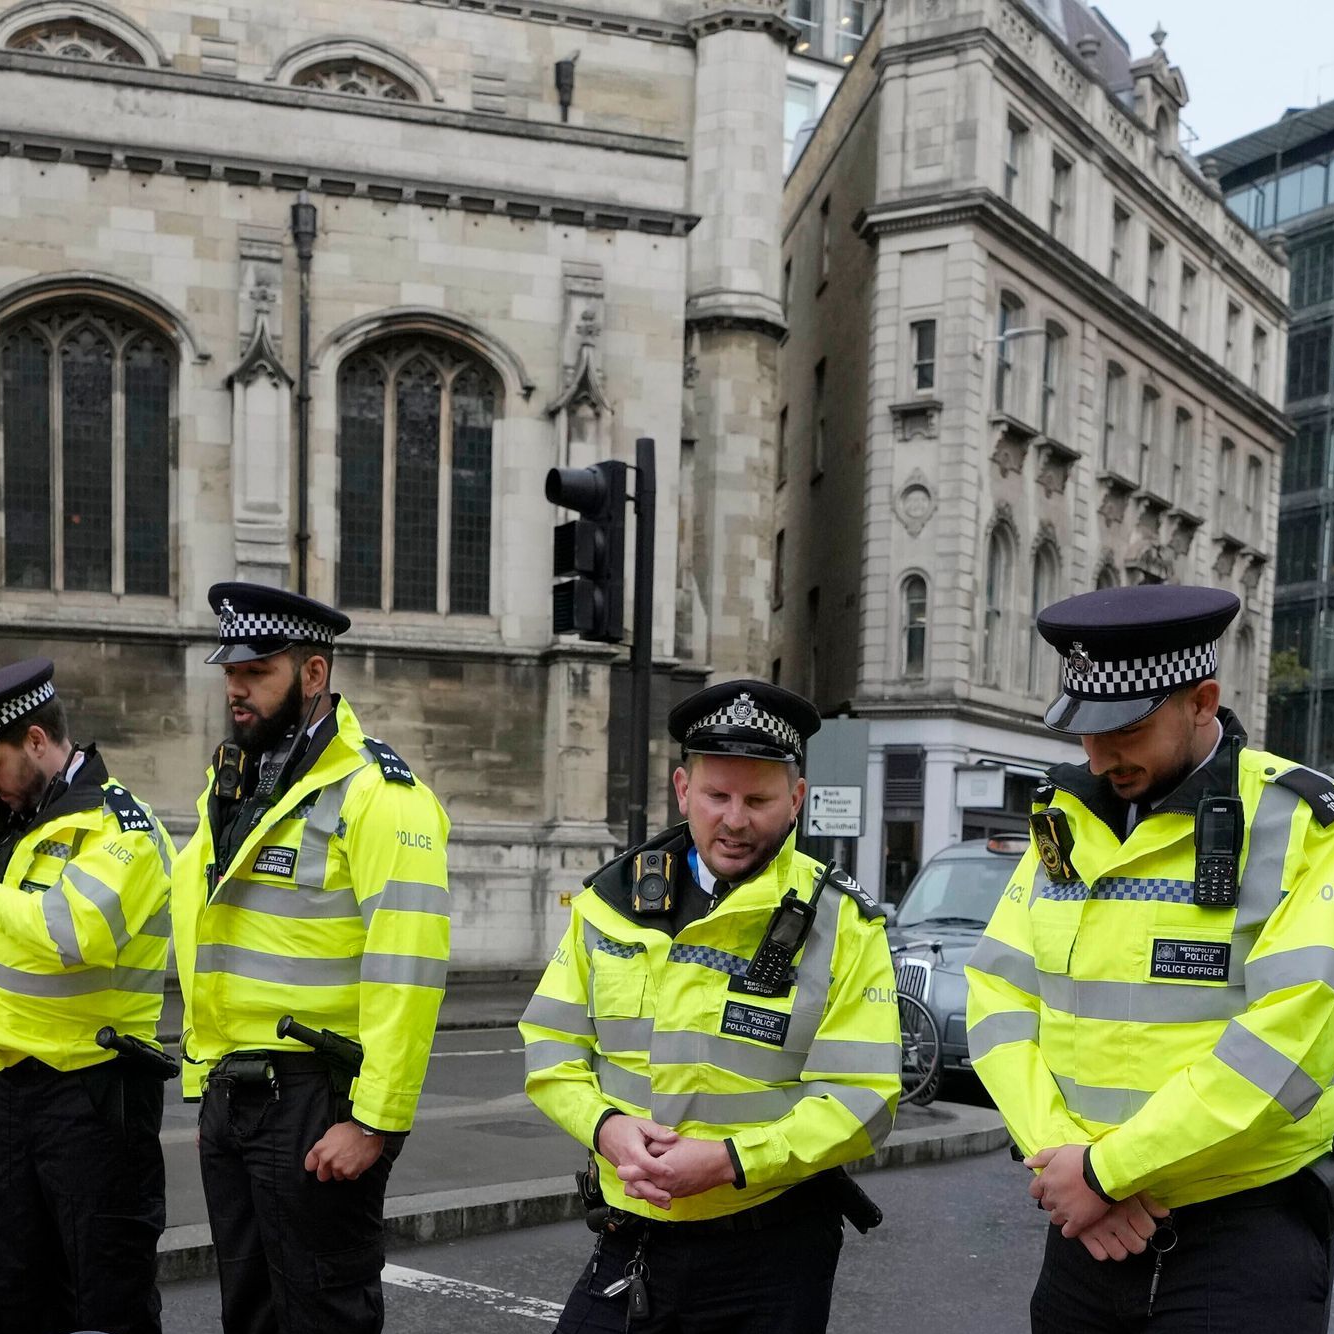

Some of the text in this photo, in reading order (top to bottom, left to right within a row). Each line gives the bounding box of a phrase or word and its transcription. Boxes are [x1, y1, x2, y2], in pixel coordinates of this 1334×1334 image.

[267, 855, 286, 863] POLICE
[255, 863, 291, 875] POLICE OFFICER
[1179, 946, 1221, 955] METROPOLITAN
[1184, 953, 1215, 962] POLICE
[1155, 964, 1224, 976] POLICE OFFICER
[747, 1011, 781, 1022] METROPOLITAN
[751, 1017, 775, 1028] POLICE
[725, 1022, 782, 1041] POLICE OFFICER
